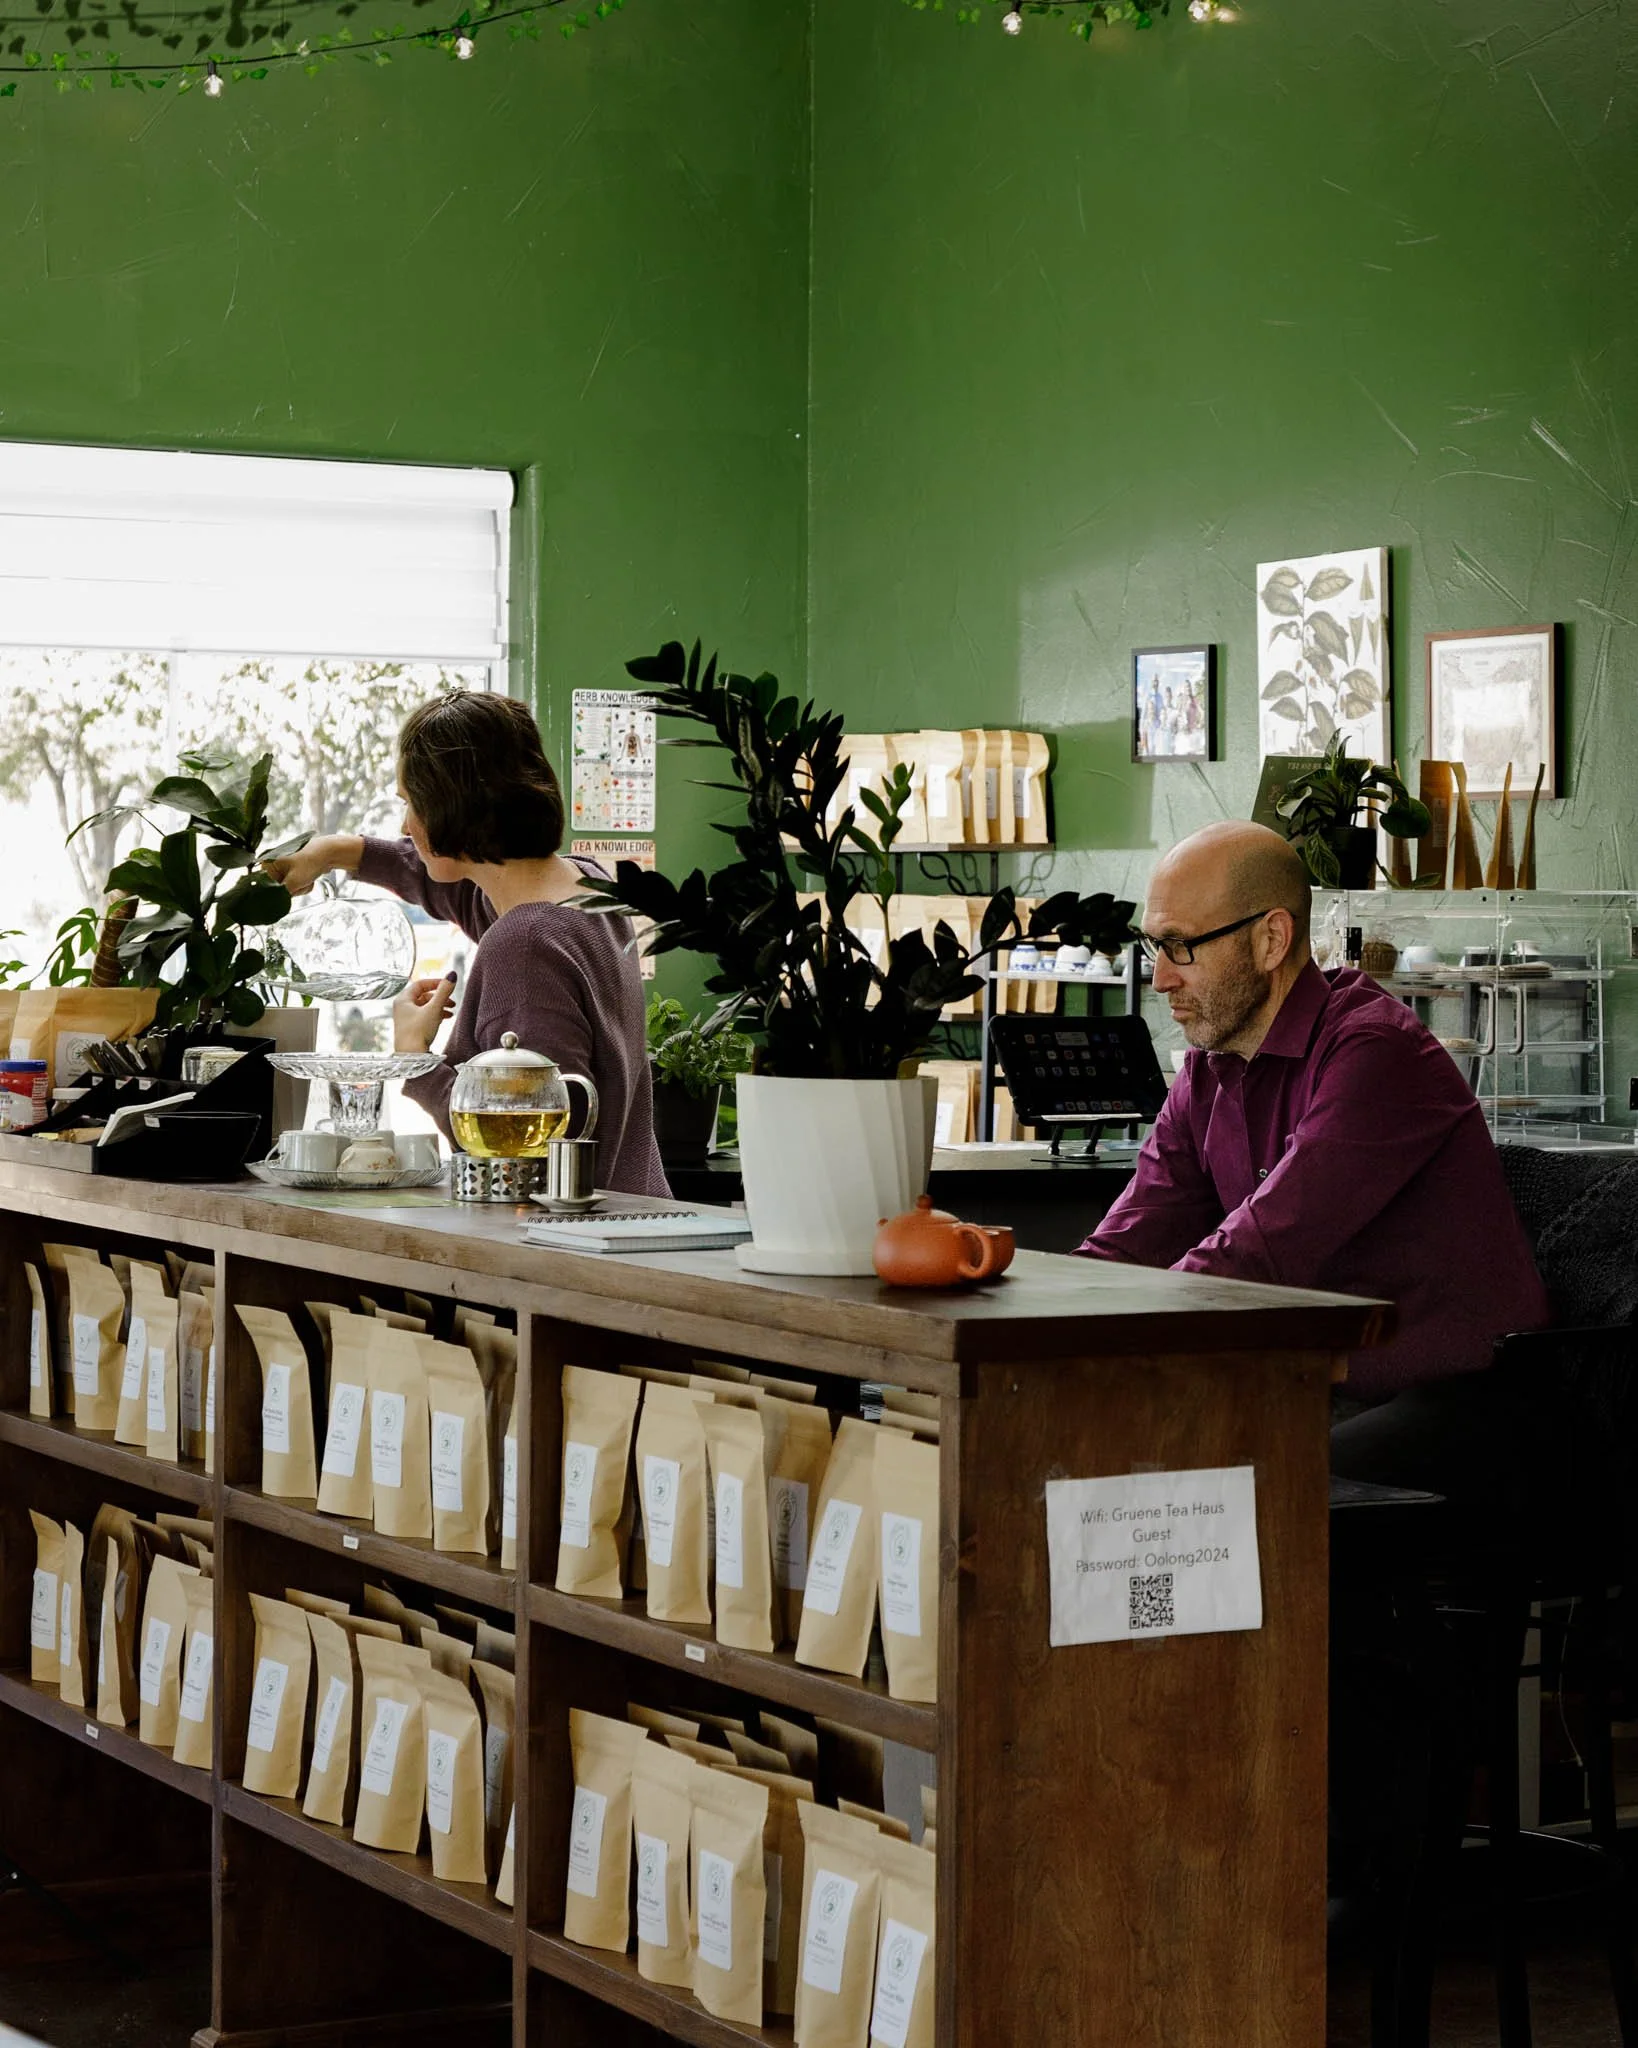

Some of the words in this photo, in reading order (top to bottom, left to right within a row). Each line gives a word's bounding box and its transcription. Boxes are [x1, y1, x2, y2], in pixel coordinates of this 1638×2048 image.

[574, 691, 598, 702] HERB
[573, 840, 592, 852] TEA
[594, 840, 655, 852] KNOWLEDGE
[1080, 1508, 1109, 1525] Wifi:
[1111, 1507, 1161, 1522] Gruene
[1165, 1503, 1189, 1518] Tea
[1192, 1502, 1225, 1516] Haus
[1132, 1528, 1172, 1543] Guest
[1075, 1555, 1140, 1574] Password:
[1144, 1547, 1230, 1568] Oolong2024
